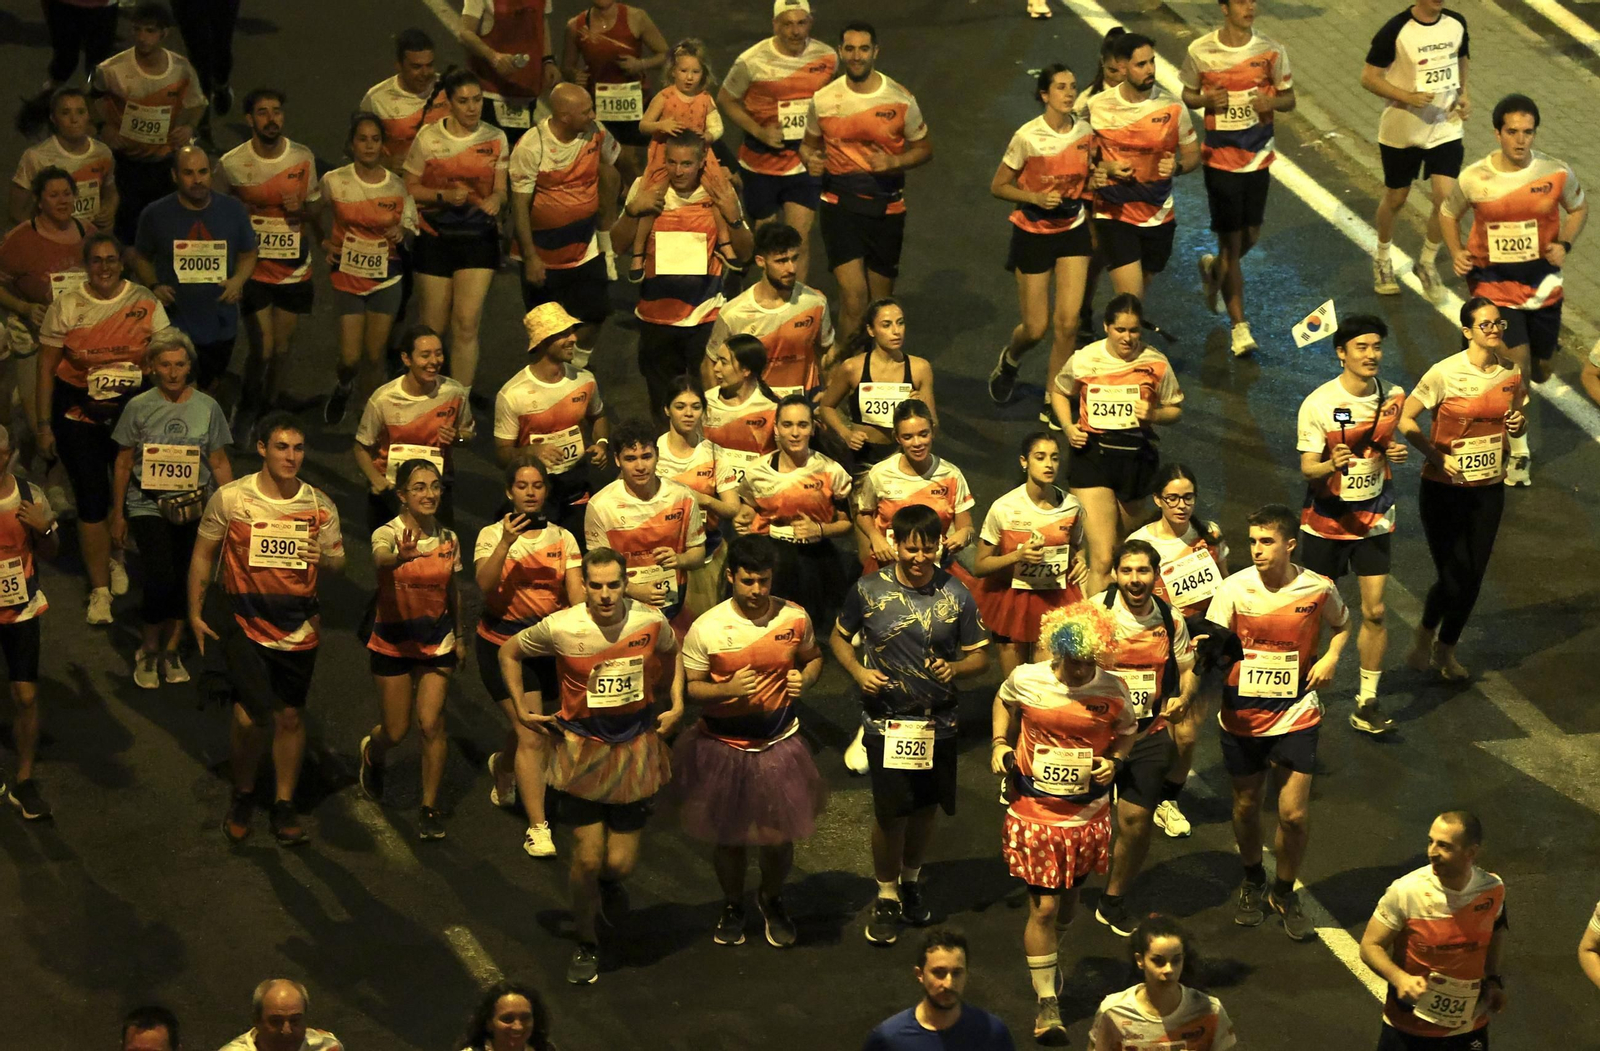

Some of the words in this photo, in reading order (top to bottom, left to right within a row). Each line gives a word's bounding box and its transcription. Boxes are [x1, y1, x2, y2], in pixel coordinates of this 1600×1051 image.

[1418, 41, 1454, 53] HITACHI
[1425, 68, 1451, 84] 2370
[601, 97, 637, 111] 11806
[131, 118, 161, 134] 9299
[784, 115, 807, 128] 248
[74, 197, 95, 213] 027
[257, 233, 294, 247] 14765
[1495, 237, 1532, 251] 12202
[179, 257, 220, 271] 20005
[346, 250, 382, 268] 14768
[1092, 403, 1133, 416] 23479
[1457, 453, 1496, 470] 12508
[150, 463, 191, 478] 17930
[697, 469, 712, 478] KH7
[931, 487, 947, 495] KH7
[665, 510, 683, 521] KH7
[260, 539, 296, 555] 9390
[1020, 562, 1060, 577] 22733
[2, 577, 19, 593] 35
[1172, 568, 1214, 596] 24845
[1295, 603, 1315, 613] KH7
[628, 636, 648, 647] KH7
[775, 631, 793, 641] KH7
[1247, 669, 1290, 685] 17750
[598, 676, 632, 694] 5734
[1130, 691, 1148, 705] 38
[895, 740, 926, 756] 5526
[1043, 766, 1079, 782] 5525
[1431, 994, 1467, 1014] 3934
